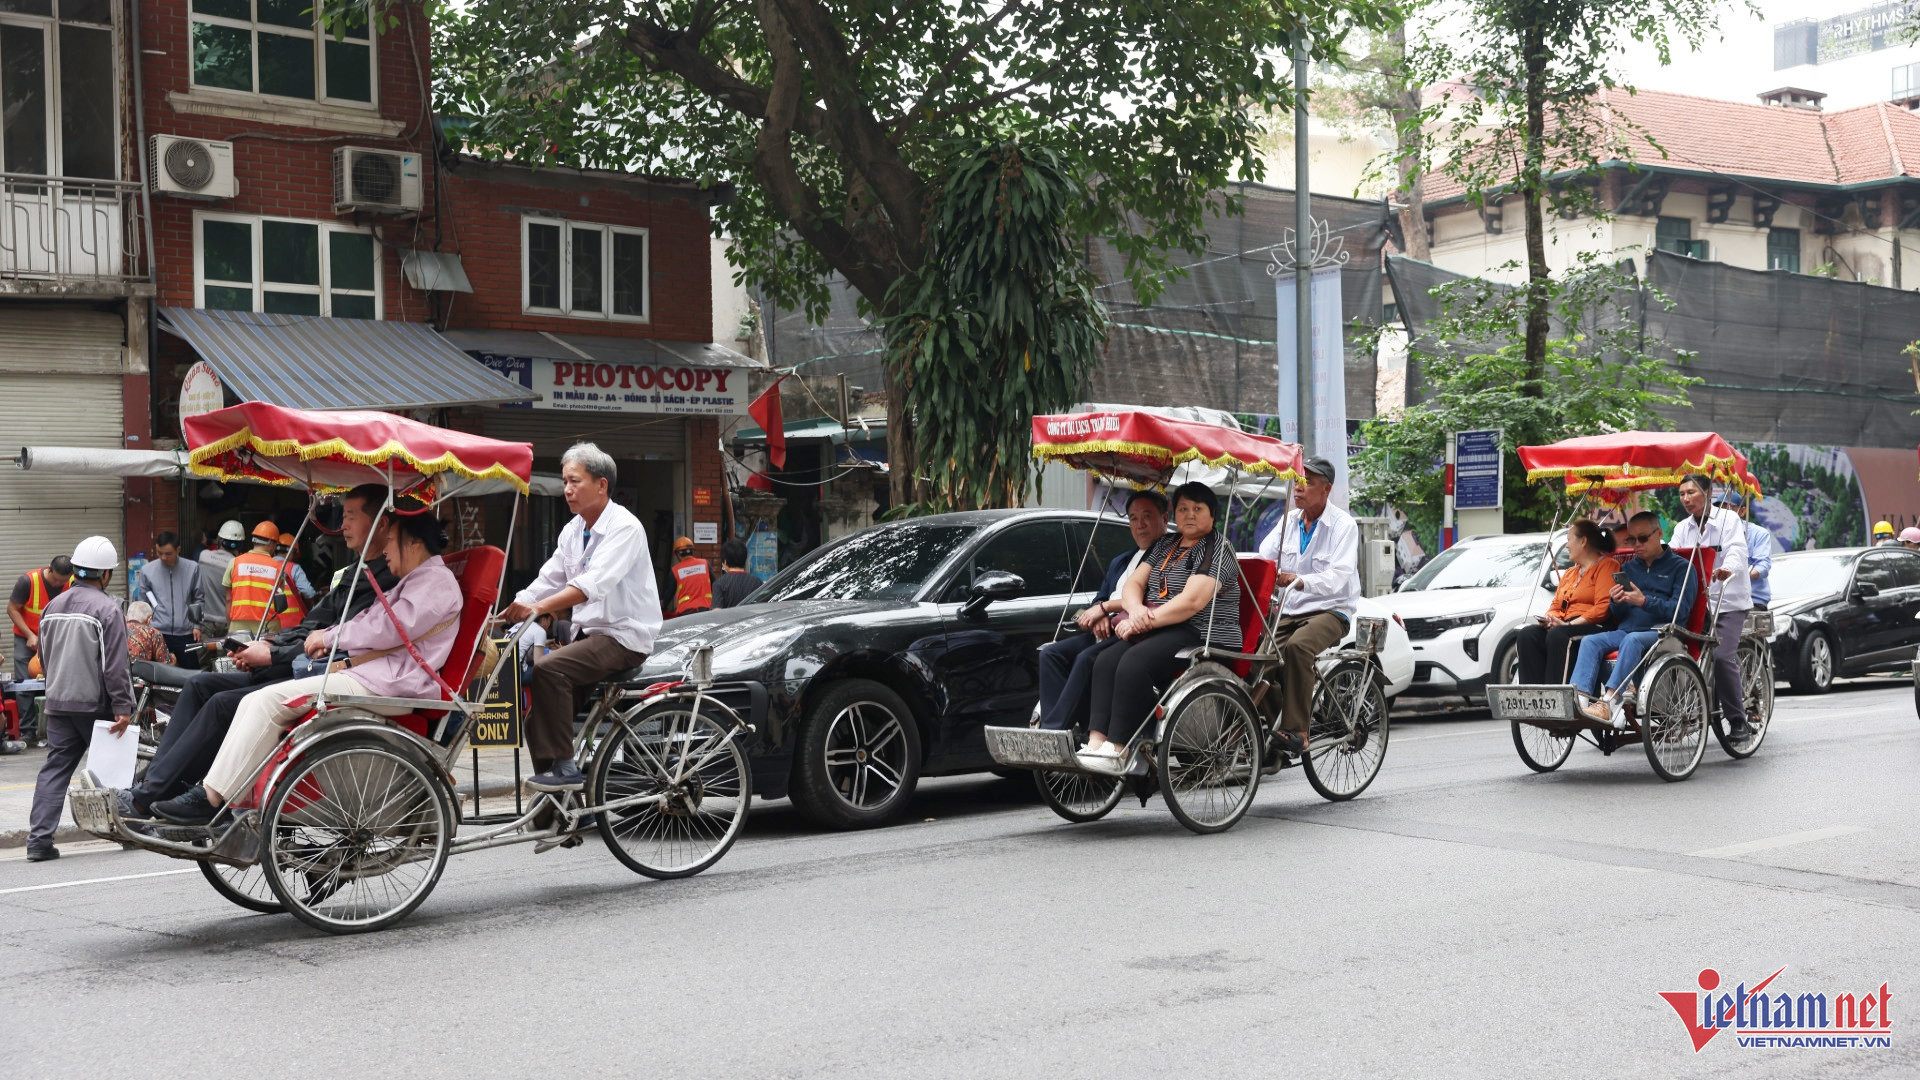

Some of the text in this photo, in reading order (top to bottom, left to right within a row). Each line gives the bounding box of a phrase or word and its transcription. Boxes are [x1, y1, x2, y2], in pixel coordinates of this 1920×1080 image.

[1834, 8, 1905, 39] RHYTHMS
[553, 361, 732, 393] PHOTOCOPY
[553, 391, 563, 400] IN
[663, 393, 685, 406] SÁCH
[702, 397, 734, 406] PLASTIC
[246, 565, 269, 574] FALCON
[477, 711, 509, 720] PARKING
[477, 723, 509, 741] ONLY
